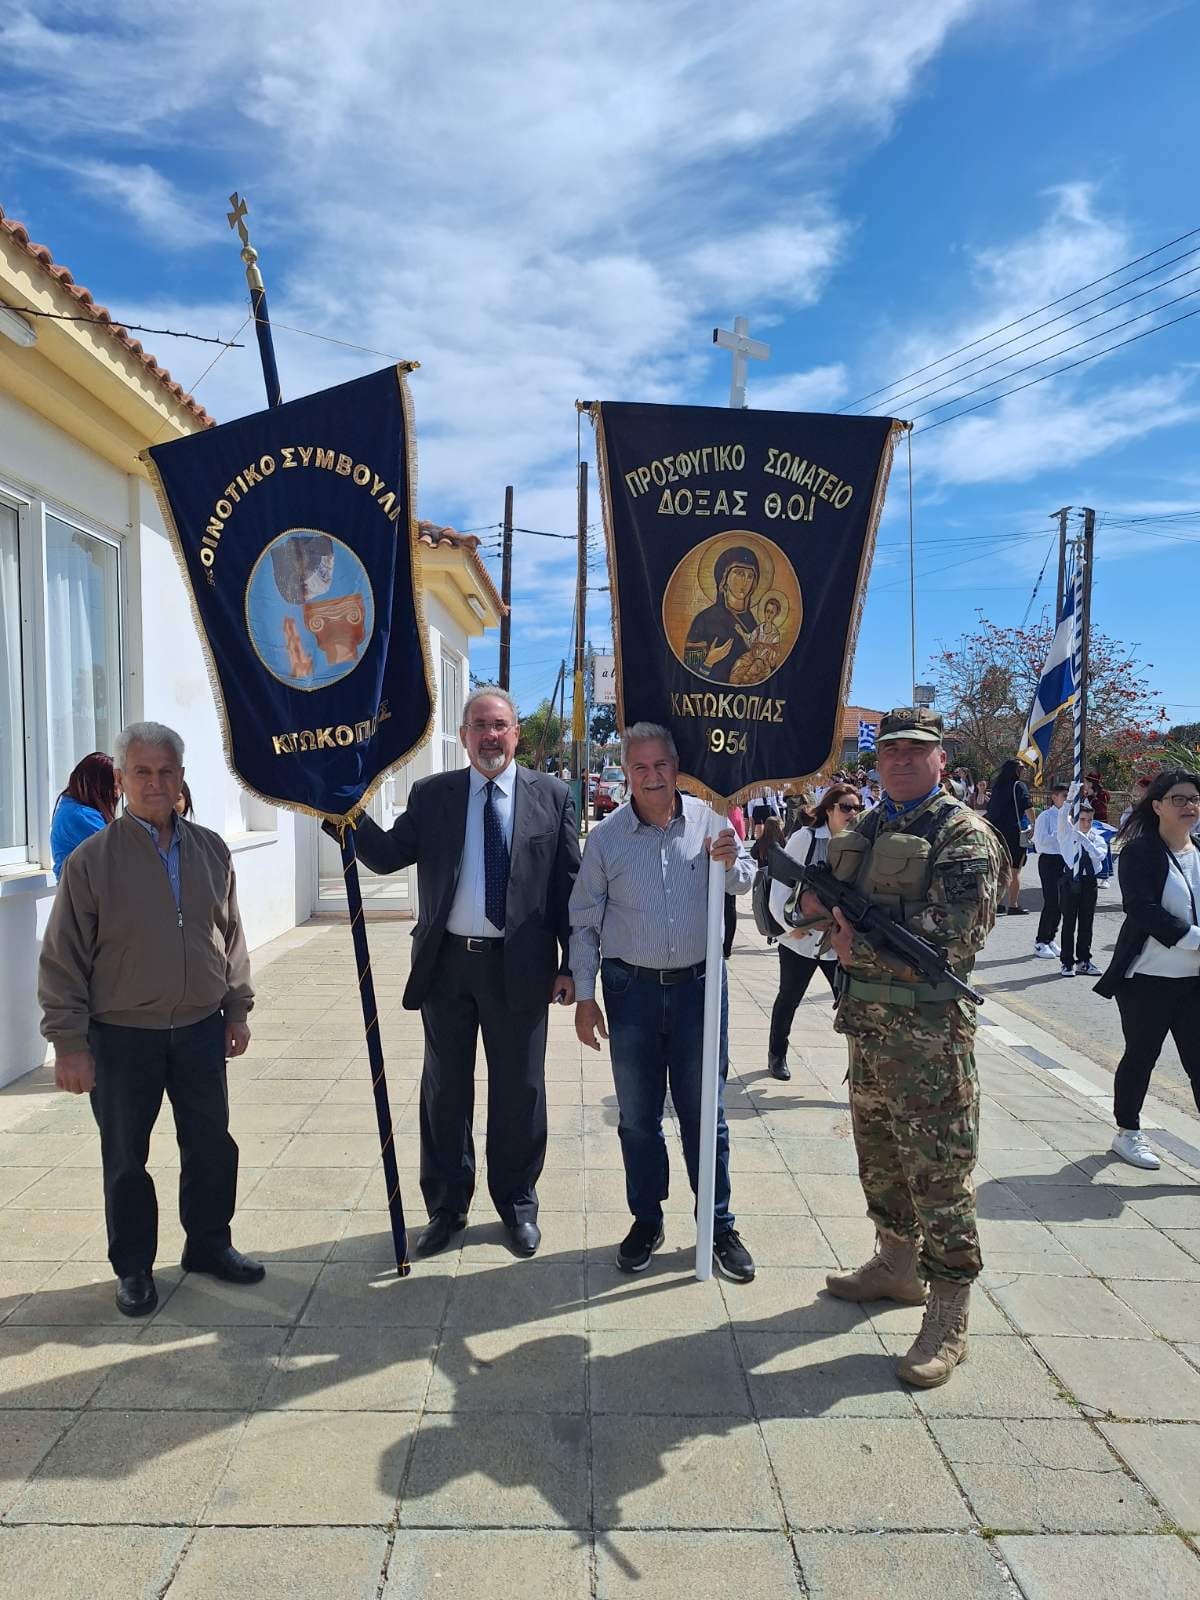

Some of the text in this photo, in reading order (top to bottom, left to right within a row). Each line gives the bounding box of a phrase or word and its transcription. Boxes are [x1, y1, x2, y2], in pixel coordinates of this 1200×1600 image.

[625, 445, 854, 510] ΠΡΟΣΦΥΓΙΚΟ ΣΩΜΑΤΕΙΟ
[657, 488, 816, 521] ΔΟΞΑΣ Θ.Ο.Ι
[671, 692, 786, 722] ΚΑΤΩΚΟΠΙΑΣ
